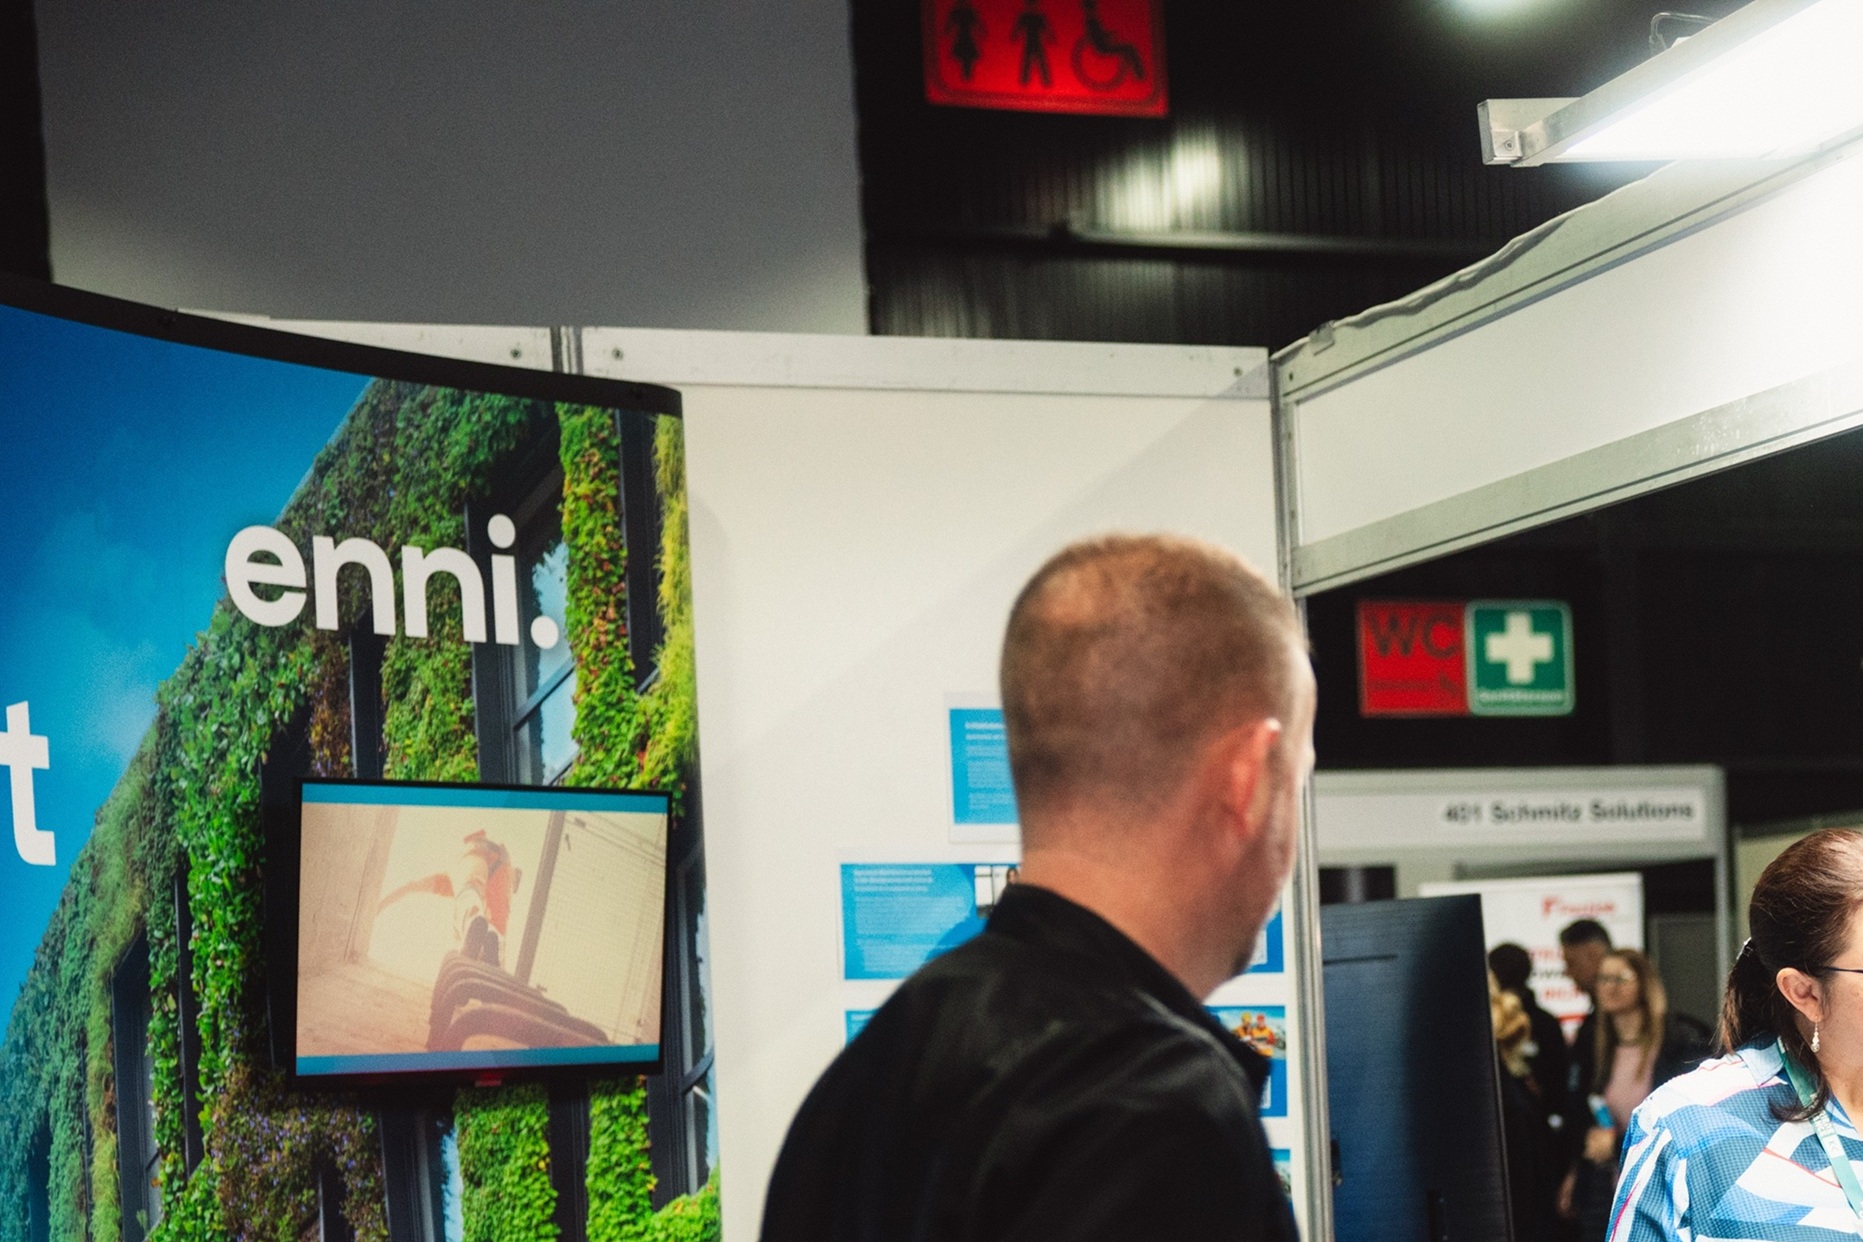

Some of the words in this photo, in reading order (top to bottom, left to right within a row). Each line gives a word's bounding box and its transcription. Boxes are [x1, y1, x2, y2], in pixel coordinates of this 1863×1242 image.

[225, 513, 559, 650] enni.
[1366, 612, 1463, 658] WC
[1446, 802, 1483, 823] 401
[1491, 800, 1582, 823] Schmitz
[1590, 798, 1694, 821] Solutions
